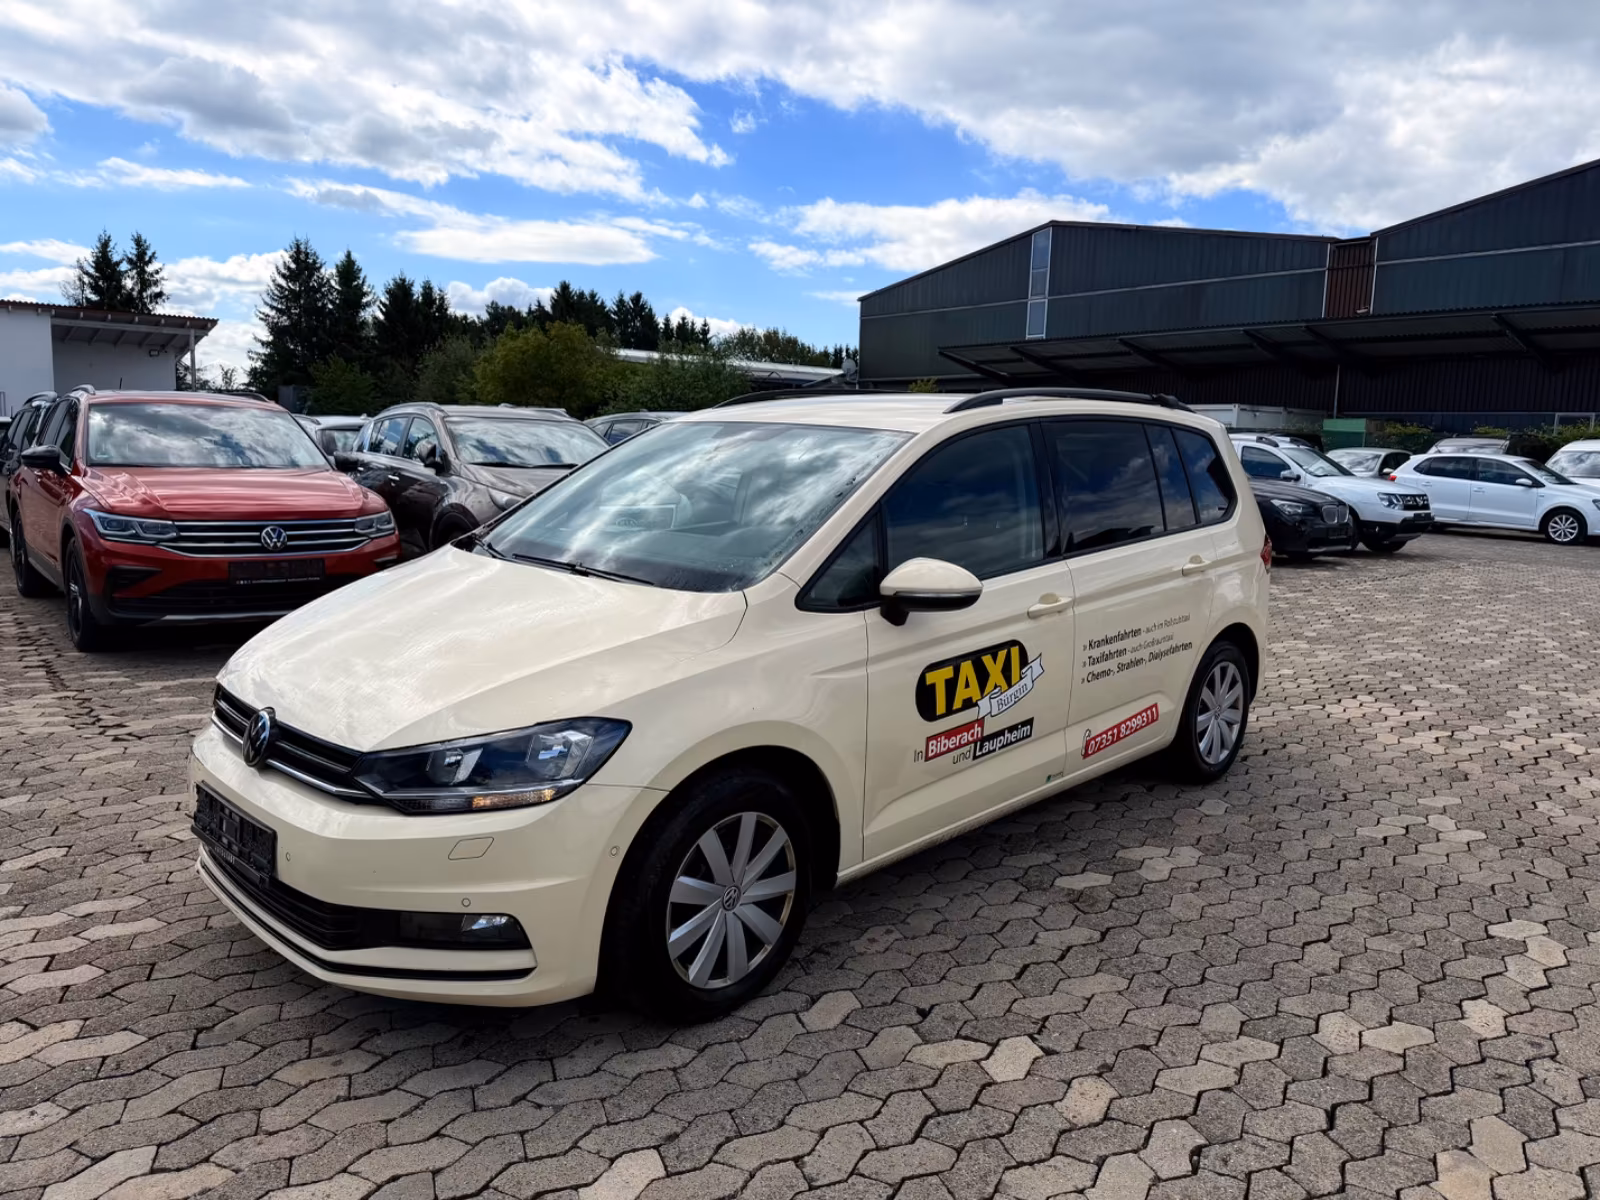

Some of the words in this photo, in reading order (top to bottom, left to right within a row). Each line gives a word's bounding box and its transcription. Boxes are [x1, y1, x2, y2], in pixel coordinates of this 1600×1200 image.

[1088, 627, 1142, 651] Krankenfahrten
[1148, 642, 1192, 663] Dialysefahrten
[1087, 647, 1127, 667] Taxifahrten
[925, 645, 1020, 716] TAXI
[996, 682, 1028, 712] Bürgin
[928, 723, 982, 758] Biberach
[952, 745, 973, 764] und
[975, 724, 1031, 757] Laupheim
[1088, 728, 1117, 754] 07351
[1120, 707, 1158, 738] 8299311
